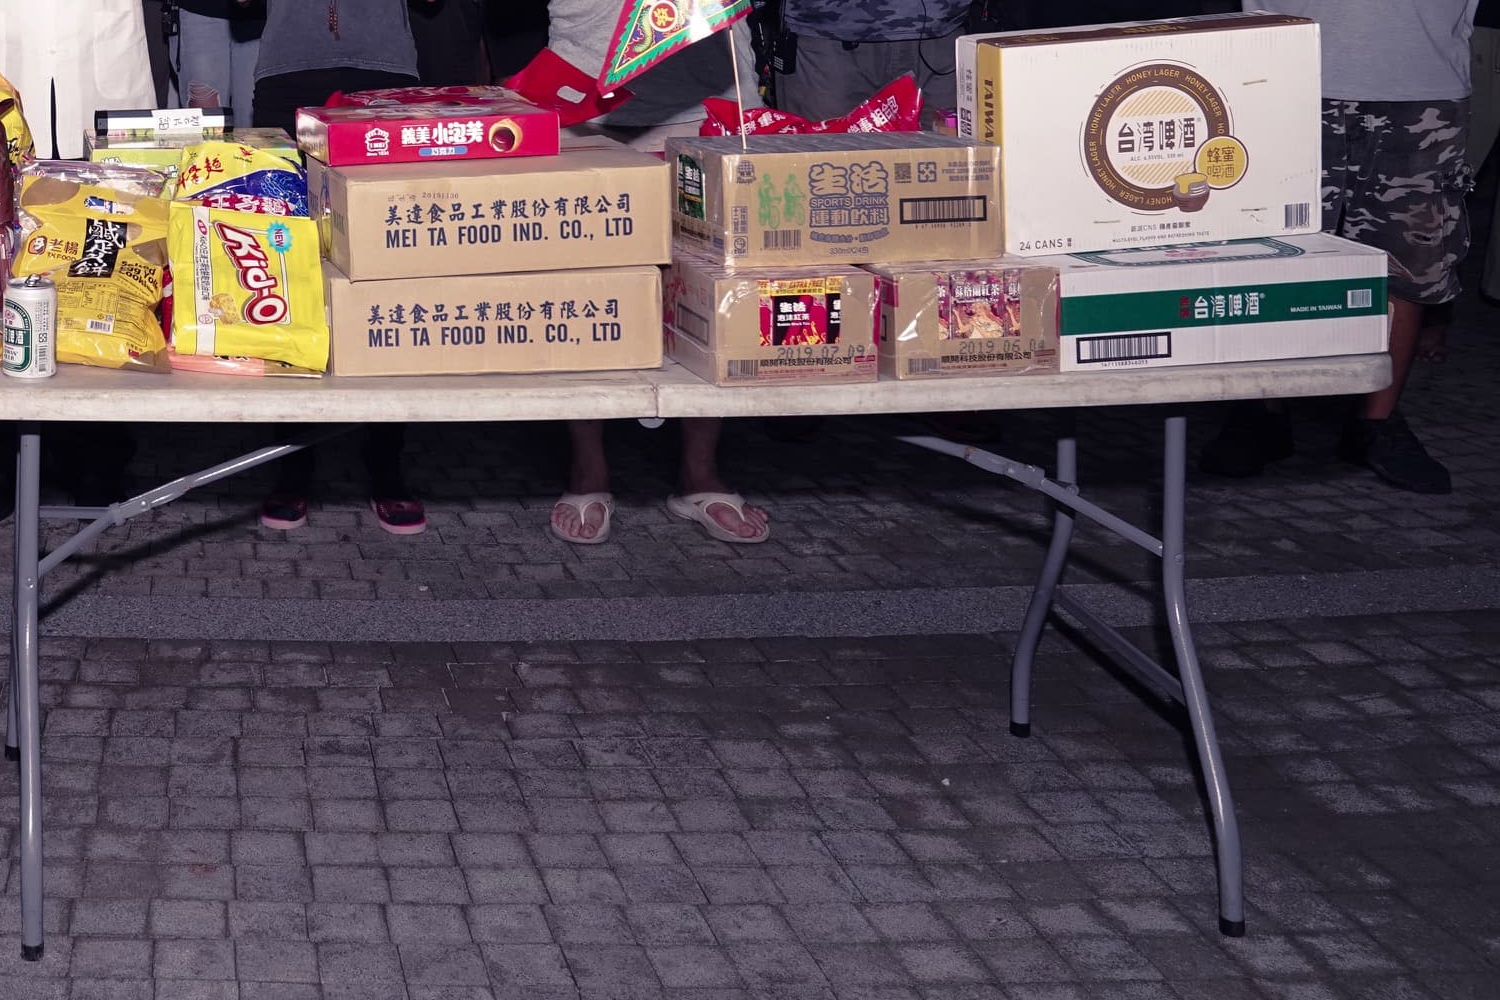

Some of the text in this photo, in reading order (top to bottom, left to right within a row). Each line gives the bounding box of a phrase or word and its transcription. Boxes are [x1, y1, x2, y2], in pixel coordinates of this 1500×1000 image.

[1125, 68, 1180, 85] HONEY LAGER
[1185, 74, 1222, 118] HONEY LAGER
[984, 79, 994, 143] TAIWA
[1089, 106, 1104, 135] HONEY
[401, 120, 485, 146] 義美 小泡芙
[1117, 116, 1196, 154] 台灣啤酒
[1206, 146, 1236, 163] 蜂蜜
[808, 160, 890, 196] 生活
[1206, 163, 1235, 178] 啤酒
[811, 196, 889, 208] SPORTS DRINK
[1118, 189, 1173, 206] HONEY LAGER
[384, 193, 632, 227] 美達食品工業股份有限公司
[810, 208, 890, 228] 運動飲料
[274, 228, 284, 248] NEW
[385, 216, 635, 249] MEI TA FOOD IND. CO., LTD
[1131, 223, 1158, 233] CNS
[1019, 238, 1064, 251] 24 CANS
[216, 222, 288, 326] Kid-O
[366, 298, 621, 327] 美達食品工業股份有限公司
[779, 301, 807, 313] 生活
[1194, 291, 1260, 320] 台灣啤酒
[1290, 305, 1308, 313] MADE
[1318, 303, 1342, 311] TAIWAN
[777, 313, 811, 322] 泡沫紅茶
[367, 322, 622, 348] MEI TA FOOD IND. CO., LTD
